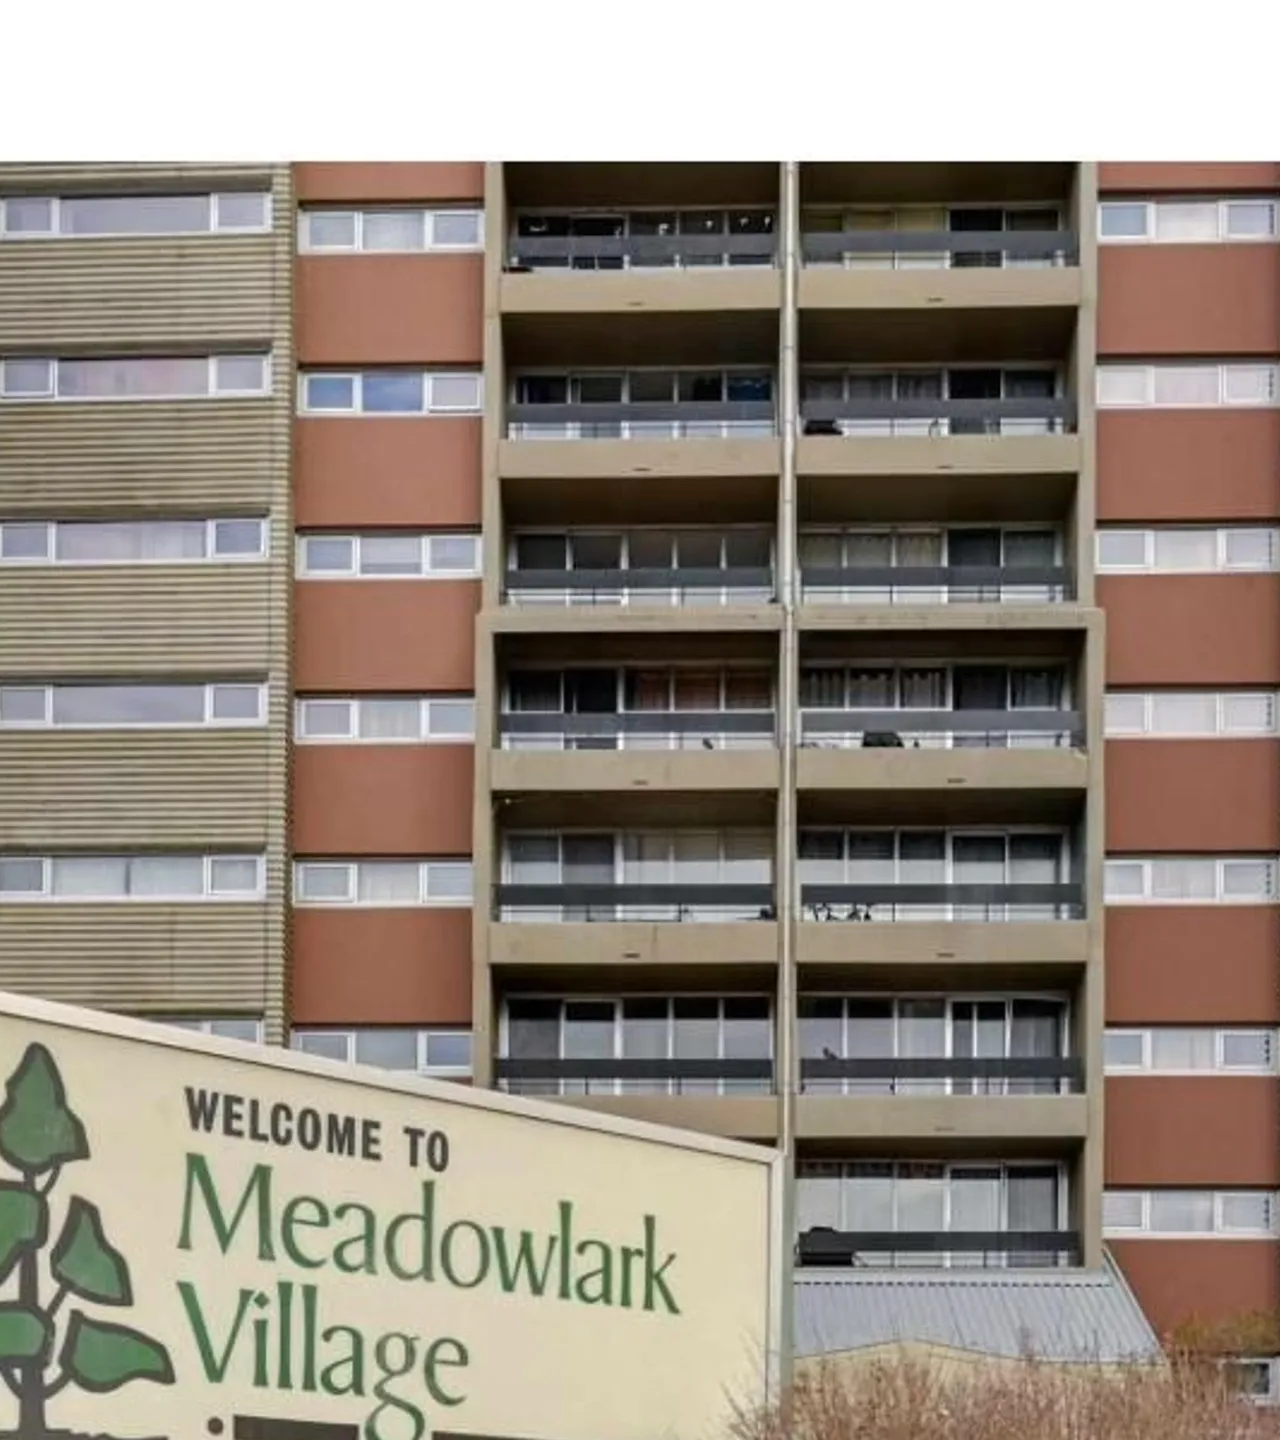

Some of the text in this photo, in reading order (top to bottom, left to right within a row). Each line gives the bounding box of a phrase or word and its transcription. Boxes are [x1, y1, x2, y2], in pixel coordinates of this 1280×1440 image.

[183, 1087, 449, 1173] WELCOME TO
[177, 1153, 680, 1315] Meadowlark
